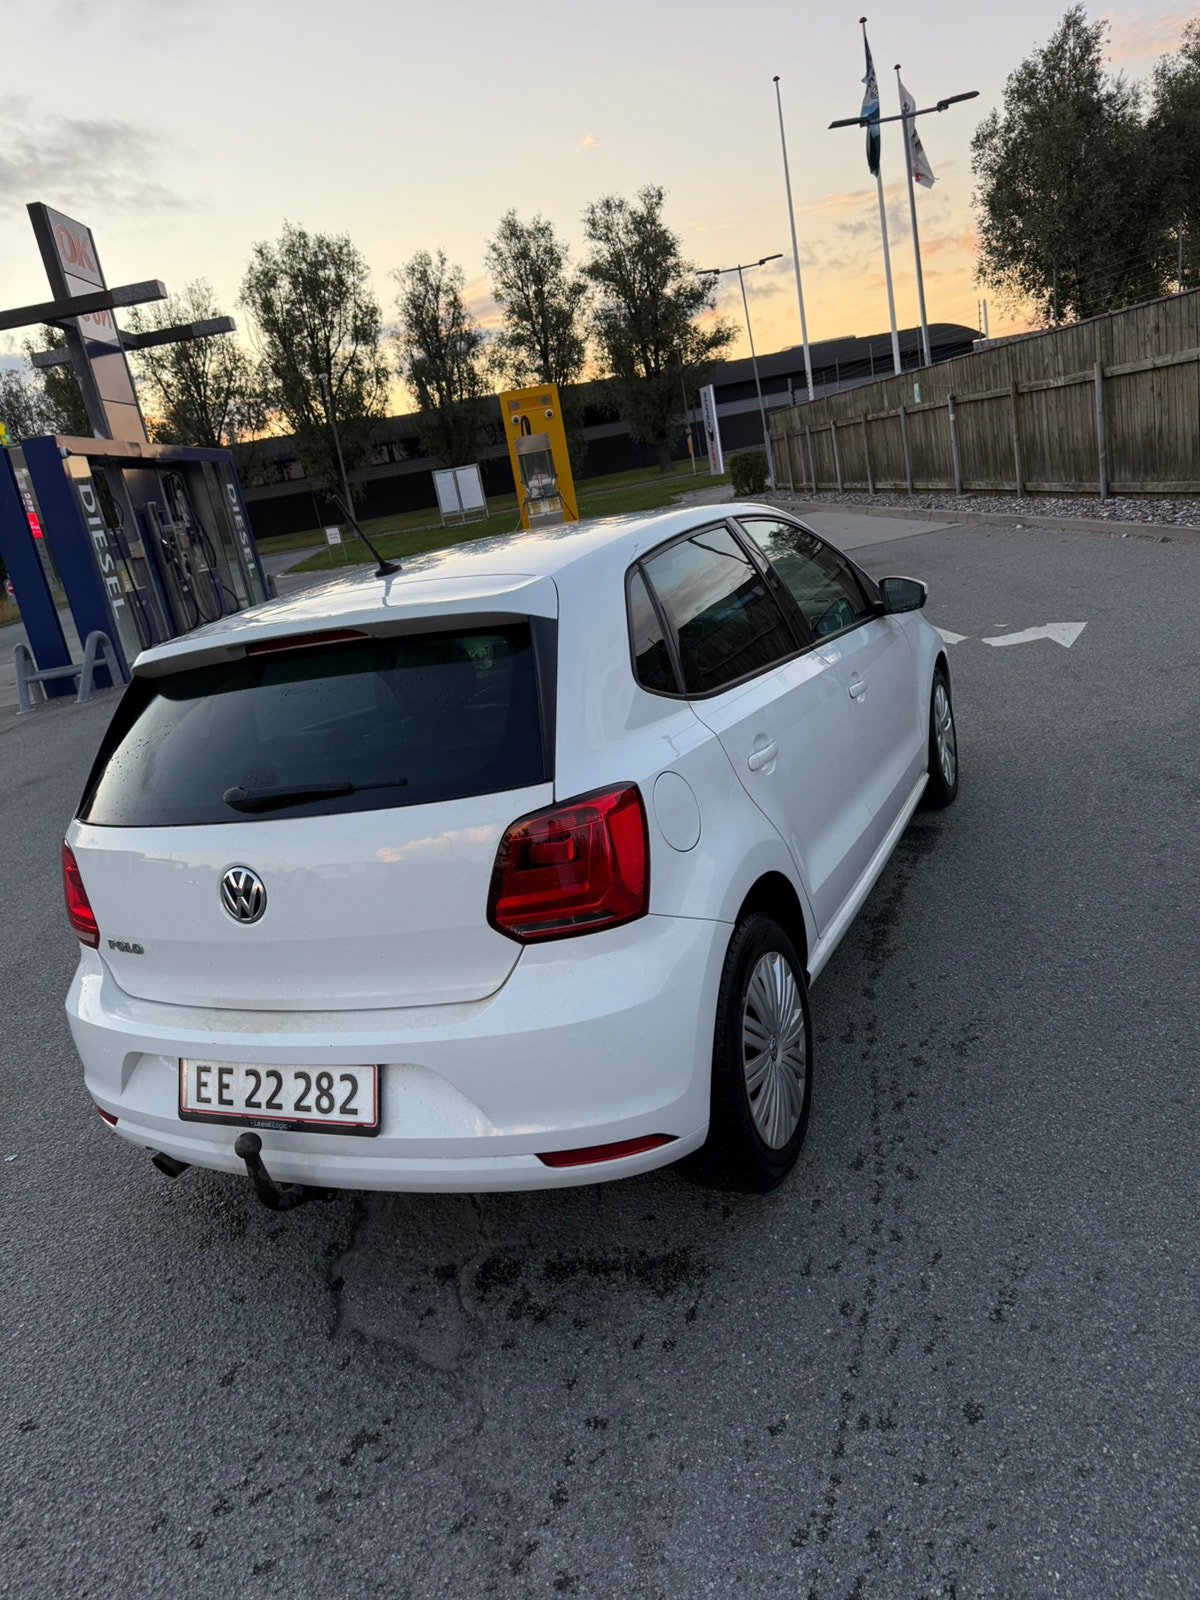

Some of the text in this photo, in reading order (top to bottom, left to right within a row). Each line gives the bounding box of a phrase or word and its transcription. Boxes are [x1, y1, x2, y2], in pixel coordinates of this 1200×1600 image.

[55, 223, 96, 273] OK
[78, 484, 126, 619] DIESEL
[226, 483, 256, 578] DIESEL
[107, 939, 144, 955] POLO
[196, 1065, 359, 1115] EE 22 282
